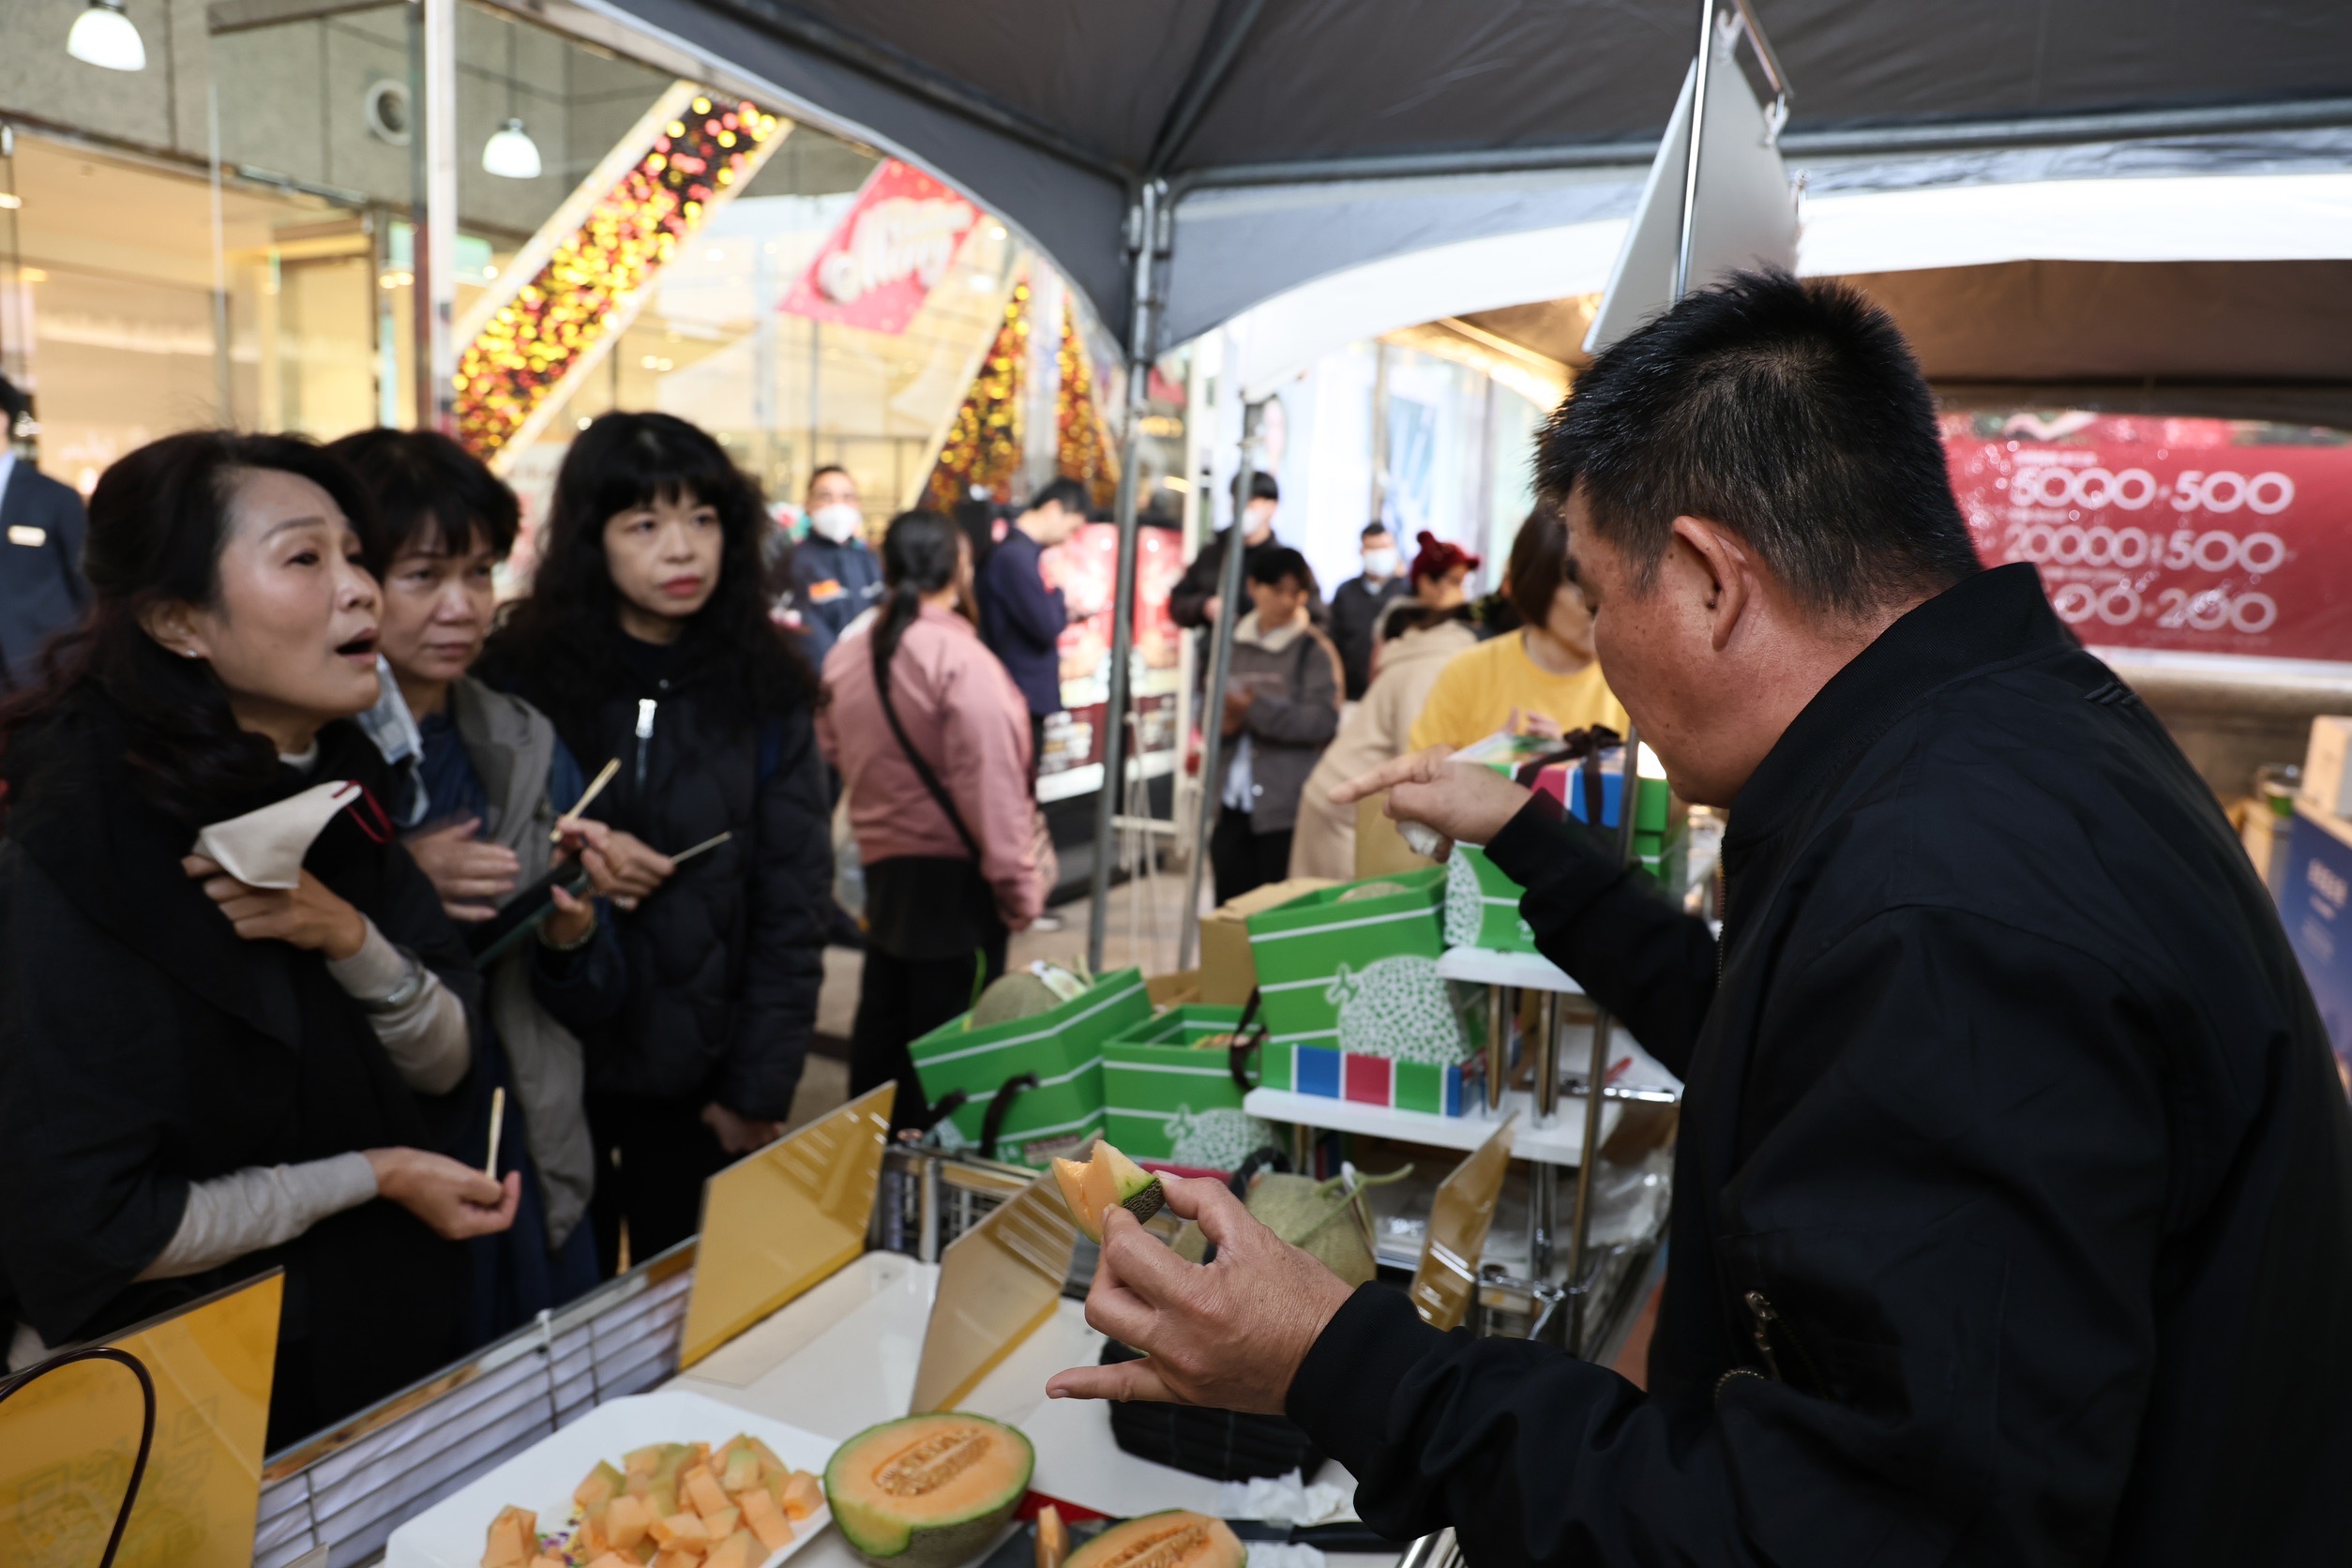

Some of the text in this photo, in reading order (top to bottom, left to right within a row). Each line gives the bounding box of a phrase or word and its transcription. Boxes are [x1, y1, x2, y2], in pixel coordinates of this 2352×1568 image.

[2170, 470, 2296, 515] 500
[2164, 529, 2286, 574] 500
[2157, 587, 2278, 633] 200
